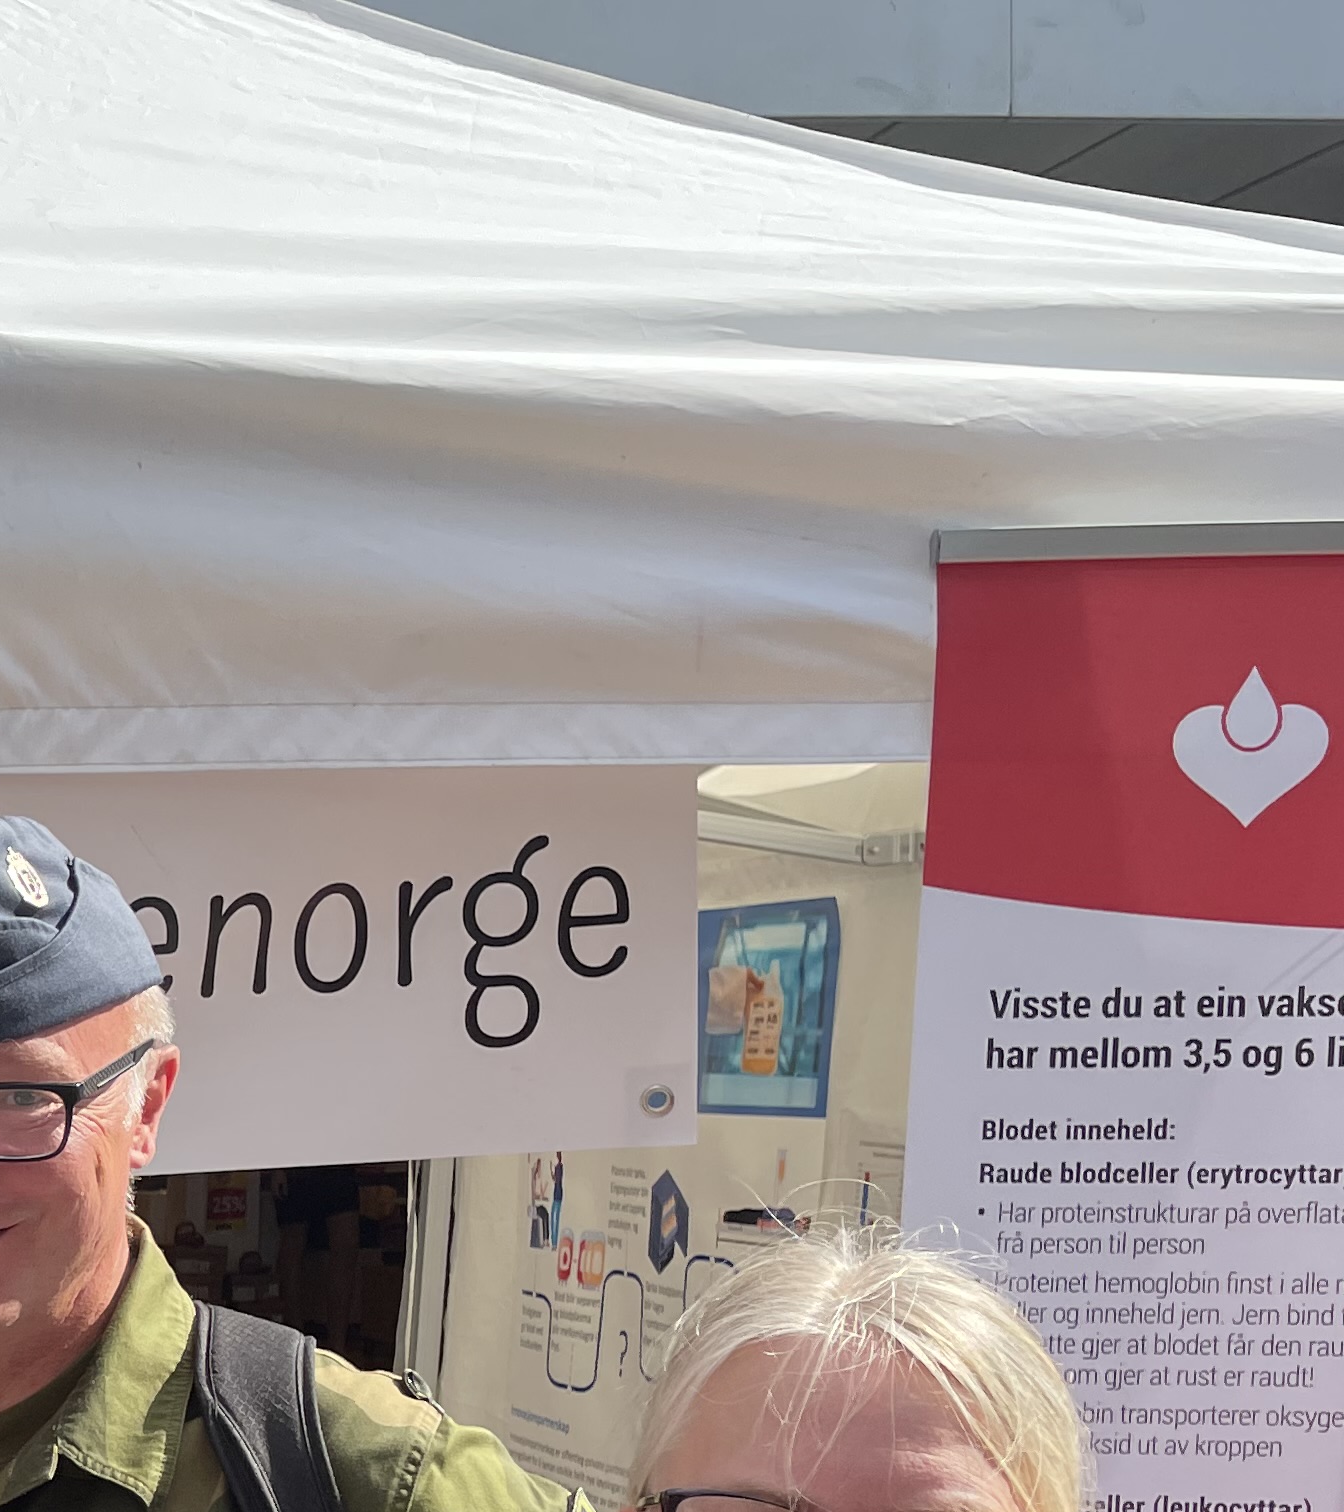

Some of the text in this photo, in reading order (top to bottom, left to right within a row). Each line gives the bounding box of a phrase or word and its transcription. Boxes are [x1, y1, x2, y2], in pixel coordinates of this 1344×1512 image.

[990, 987, 1091, 1018] Visste
[1102, 987, 1142, 1018] du
[1153, 990, 1186, 1018] at
[1196, 986, 1246, 1018] ein
[985, 1037, 1038, 1069] har
[1049, 1037, 1172, 1069] mellom
[1183, 1038, 1232, 1074] 3,5
[1242, 1046, 1282, 1076] og
[1295, 1038, 1314, 1067] 6
[982, 1118, 1176, 1141] Blodet inneheld:
[979, 1162, 1052, 1184] Raude
[1060, 1161, 1178, 1184] blodceller
[998, 1201, 1344, 1229] Har proteinstrukturar på overflat
[997, 1231, 1205, 1260] frå person til person
[1094, 1271, 1219, 1297] hemoglobin
[1227, 1271, 1273, 1295] finst
[1279, 1272, 1285, 1295] i
[1291, 1272, 1329, 1295] alle
[1053, 1301, 1334, 1330] og inneheld jern. Jern bind
[1082, 1332, 1122, 1360] gjer
[1127, 1337, 1147, 1356] at
[1154, 1335, 1219, 1357] blodet
[1227, 1333, 1255, 1356] får
[1262, 1334, 1301, 1357] den
[1105, 1362, 1142, 1391] gjer
[1150, 1367, 1169, 1386] at
[1176, 1367, 1216, 1386] rust
[1223, 1370, 1245, 1387] er
[1251, 1364, 1314, 1388] raudt!
[1121, 1405, 1262, 1428] transporterer
[1138, 1436, 1158, 1456] ut
[1164, 1440, 1187, 1456] av
[1195, 1434, 1282, 1462] kroppen
